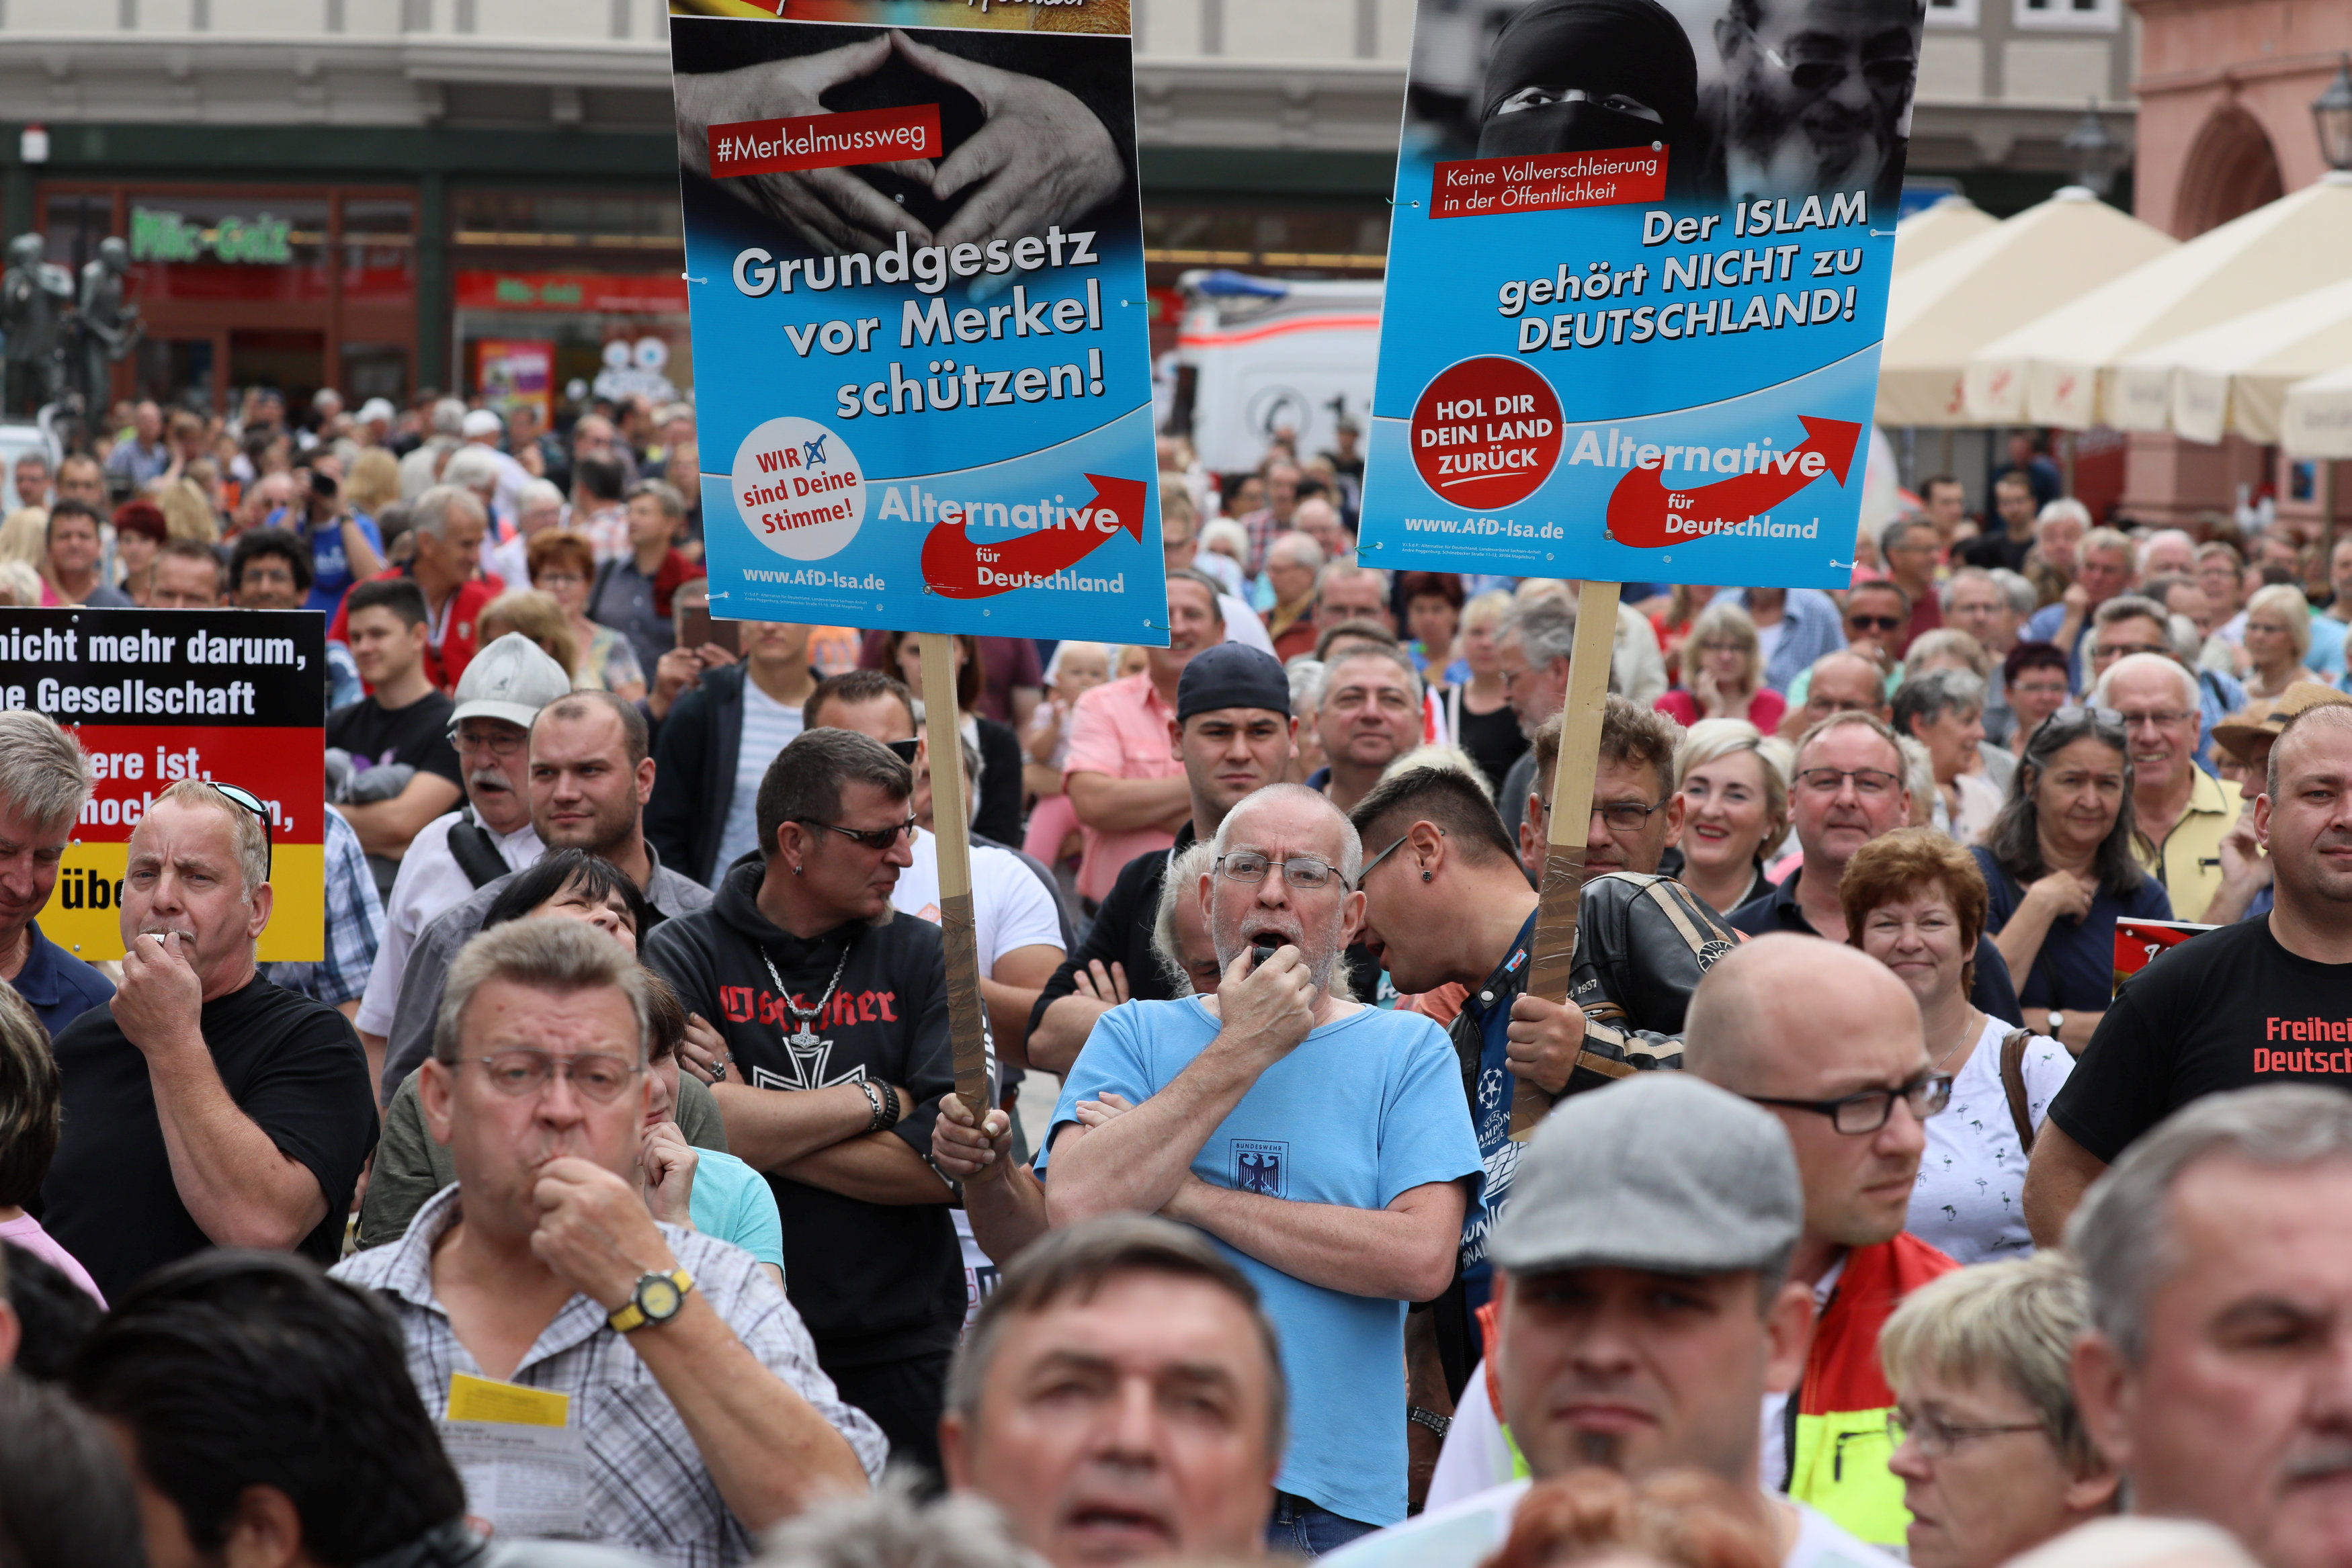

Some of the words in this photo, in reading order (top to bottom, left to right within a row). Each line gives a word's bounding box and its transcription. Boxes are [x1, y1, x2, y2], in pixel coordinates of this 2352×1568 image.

[717, 124, 926, 163] #Merkelmussweg
[1445, 165, 1497, 188] Keine
[1502, 157, 1658, 183] Vollverschleierung
[1443, 194, 1460, 212] in
[1465, 190, 1496, 210] der
[1501, 182, 1616, 206] Öffentlichkeit
[1642, 208, 1719, 247] Der
[1733, 190, 1867, 236] ISLAM
[732, 225, 1098, 297] Grundgesetz
[1497, 261, 1647, 316] gehört
[1661, 245, 1799, 292] NICHT
[1810, 247, 1862, 276] zu
[783, 316, 881, 357] vor
[900, 277, 1103, 349] Merkel
[1517, 285, 1857, 353] DEUTSCHLAND!
[836, 347, 1105, 420] schützen!
[1436, 399, 1488, 421] HOL
[1495, 394, 1535, 415] DIR
[1421, 424, 1478, 448] DEIN
[1486, 418, 1553, 442] LAND
[756, 447, 801, 473] WIR
[1438, 445, 1538, 476] ZURÜCK
[1568, 428, 1826, 477] Alternative
[743, 481, 790, 508] sind
[794, 469, 857, 498] Deine
[1668, 493, 1695, 509] für
[761, 498, 853, 535] Stimme!
[878, 485, 1120, 533] Alternative
[1405, 518, 1564, 539] www.AfD-lsa.de
[1665, 514, 1818, 539] Deutschland
[976, 548, 1001, 564] für
[743, 567, 885, 591] www.AfD-lsa.de
[978, 567, 1124, 594] Deutschland
[89, 629, 176, 663] mehr
[187, 630, 306, 670] darum,
[37, 677, 255, 715] Gesellschaft
[157, 746, 212, 782] ist,
[1577, 978, 1597, 994] 1937
[1236, 1143, 1282, 1151] BUNDESWEHR
[1480, 1129, 1505, 1149] EAGUE
